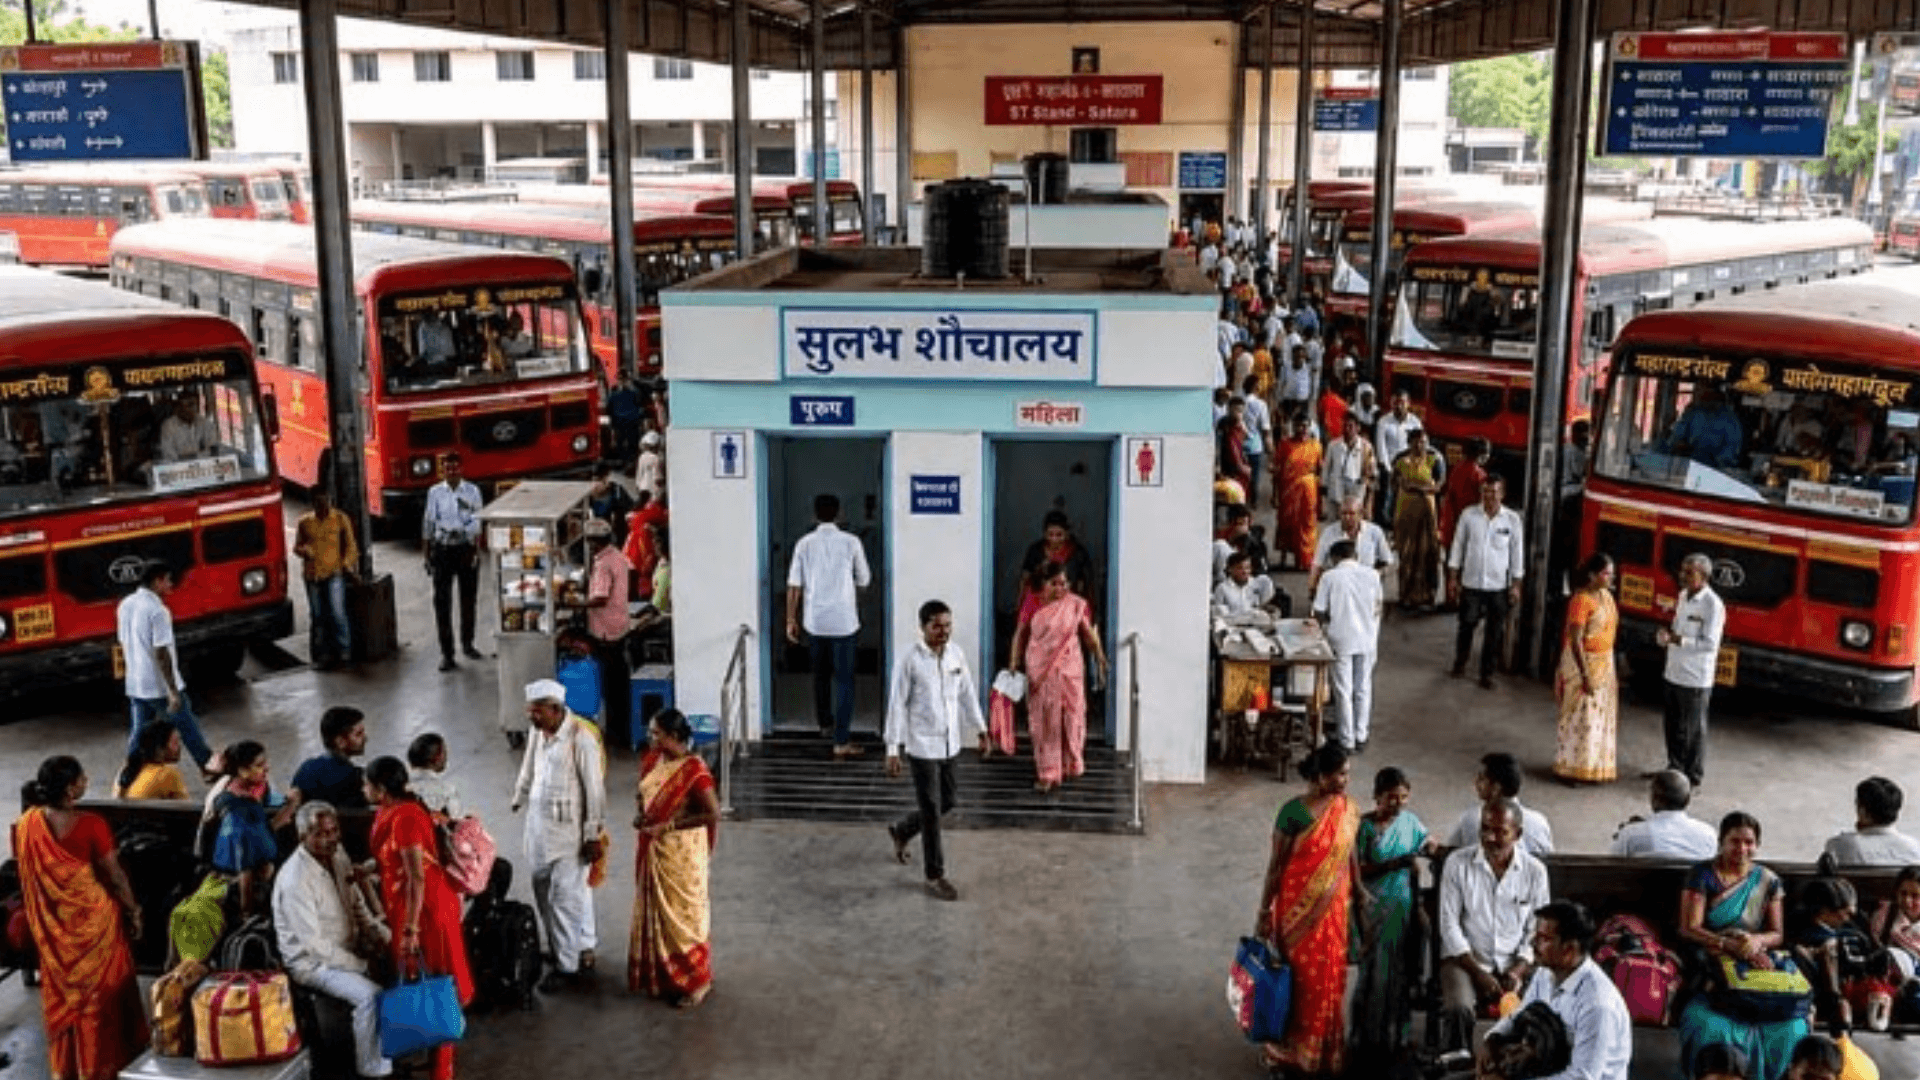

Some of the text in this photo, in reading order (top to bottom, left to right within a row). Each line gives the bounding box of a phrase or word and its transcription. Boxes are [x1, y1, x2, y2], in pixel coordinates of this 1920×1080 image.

[1009, 105, 1029, 120] ST
[1033, 105, 1076, 120] Stand
[797, 314, 1083, 372] सुलभ शौचालय
[1020, 402, 1080, 425] महिला
